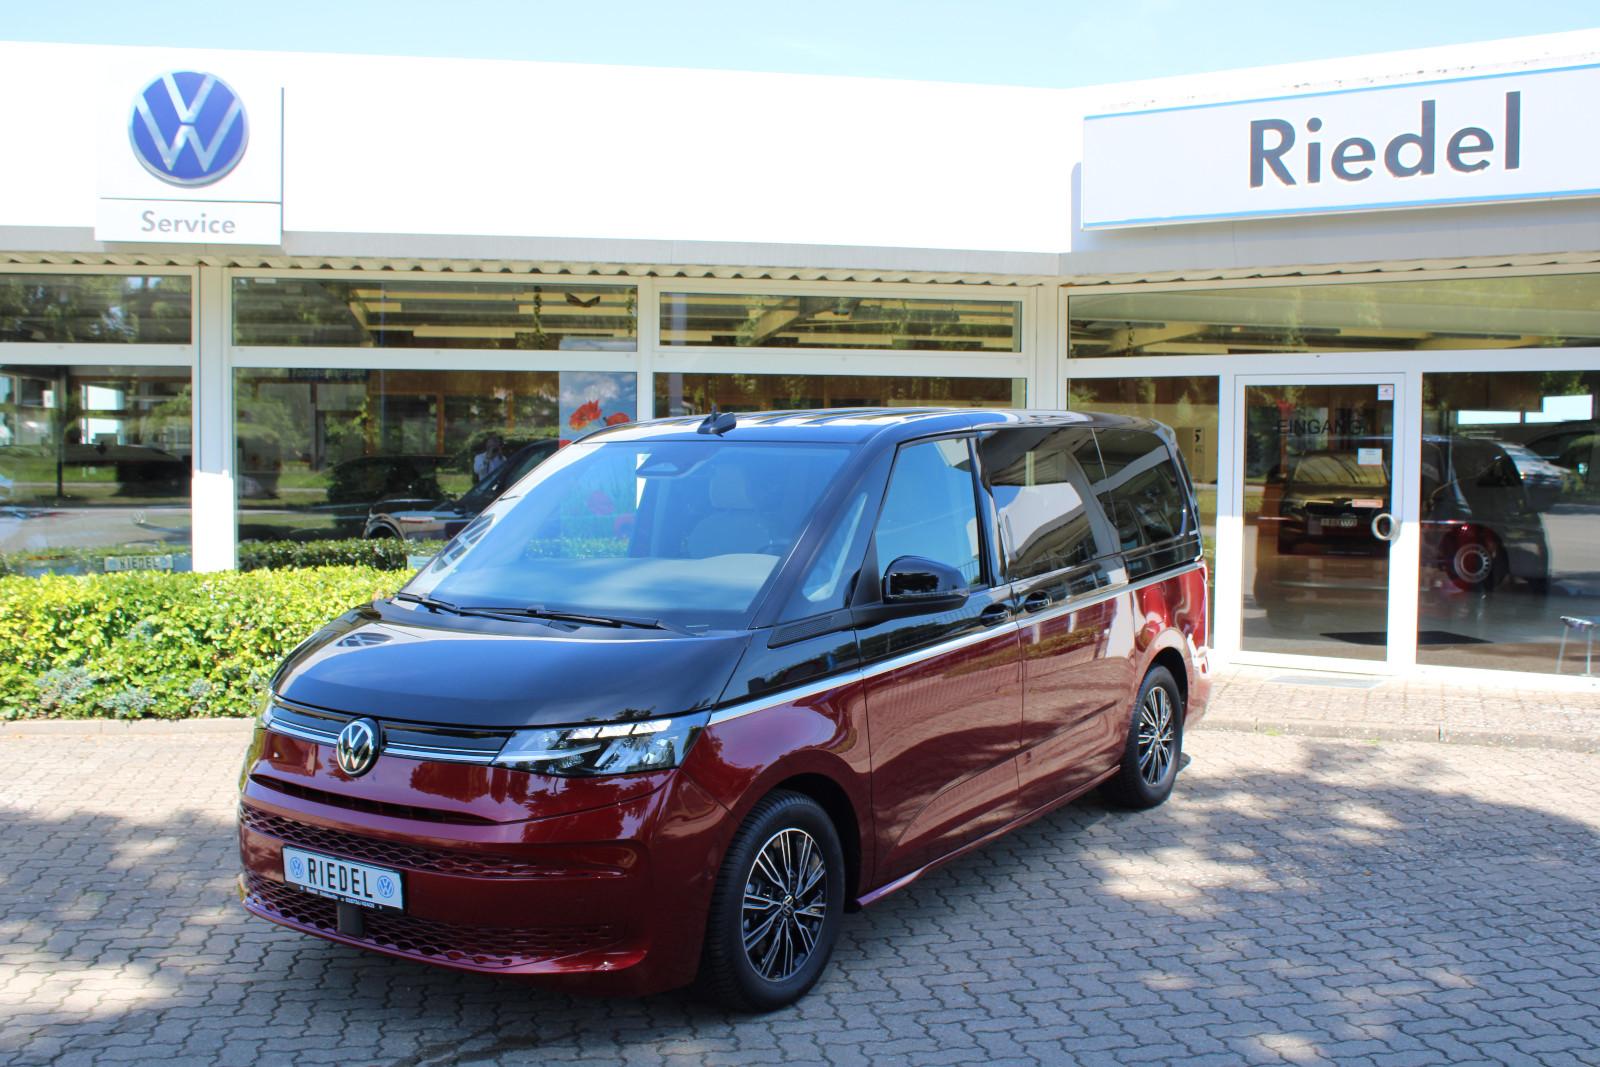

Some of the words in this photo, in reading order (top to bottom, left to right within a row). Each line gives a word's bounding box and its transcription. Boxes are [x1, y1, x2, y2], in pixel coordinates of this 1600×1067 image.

[1250, 91, 1521, 187] Riedel
[141, 210, 236, 233] Service
[1277, 419, 1363, 435] EINGANG
[307, 857, 373, 898] RIEDEL
